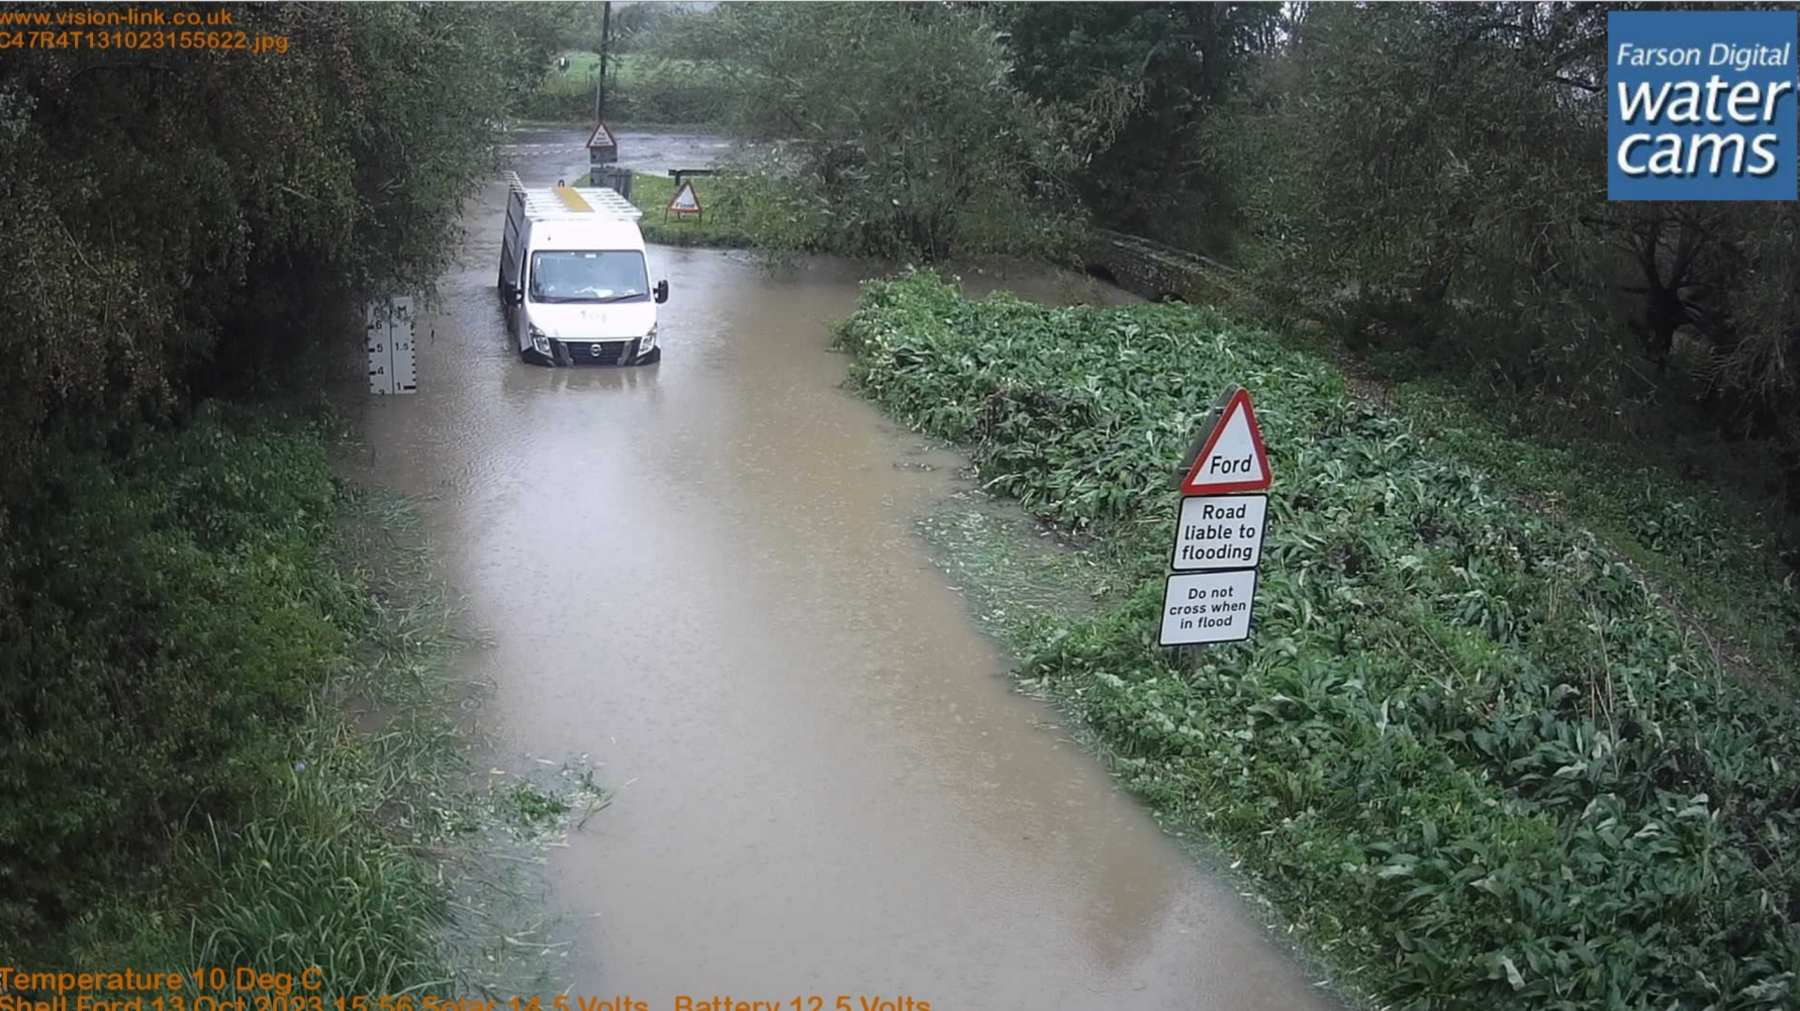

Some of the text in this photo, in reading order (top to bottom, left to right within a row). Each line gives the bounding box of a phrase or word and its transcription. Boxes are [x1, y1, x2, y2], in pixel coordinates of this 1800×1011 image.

[375, 320, 383, 330] 6
[376, 343, 384, 353] 5
[395, 342, 409, 351] 1.5
[377, 366, 385, 375] 4
[396, 382, 401, 391] 1
[1210, 453, 1253, 475] Ford
[1202, 503, 1247, 520] Road
[1184, 523, 1256, 541] liable to
[1182, 543, 1253, 561] flooding
[1188, 585, 1234, 600] Do not
[1169, 600, 1246, 616] cross when
[1180, 615, 1233, 630] in flood
